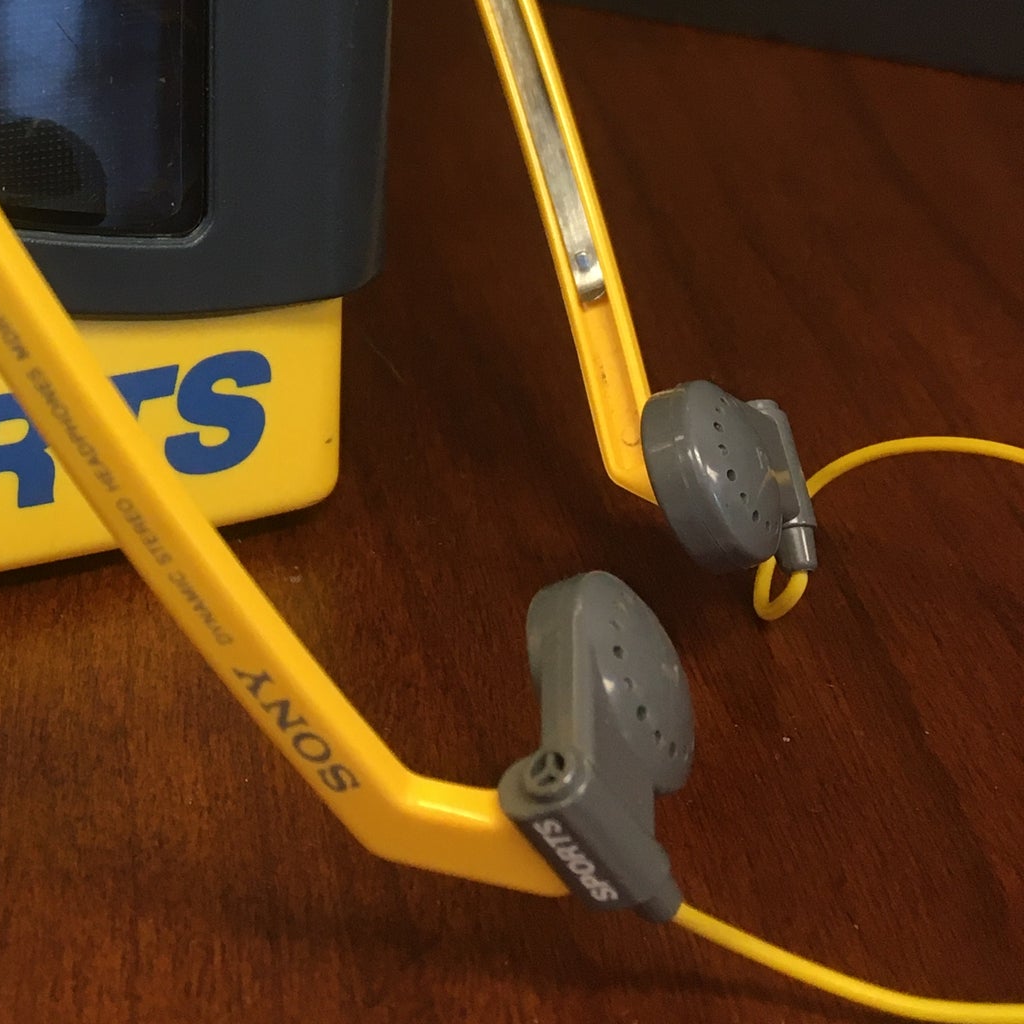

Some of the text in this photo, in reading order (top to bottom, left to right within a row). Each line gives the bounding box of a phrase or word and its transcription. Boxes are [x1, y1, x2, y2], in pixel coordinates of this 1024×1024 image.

[25, 365, 121, 492] HEADPHONES
[115, 495, 173, 566] STEREO
[169, 571, 234, 648] DYNAMIC
[233, 667, 360, 795] SONY
[533, 818, 619, 902] SPORTS
